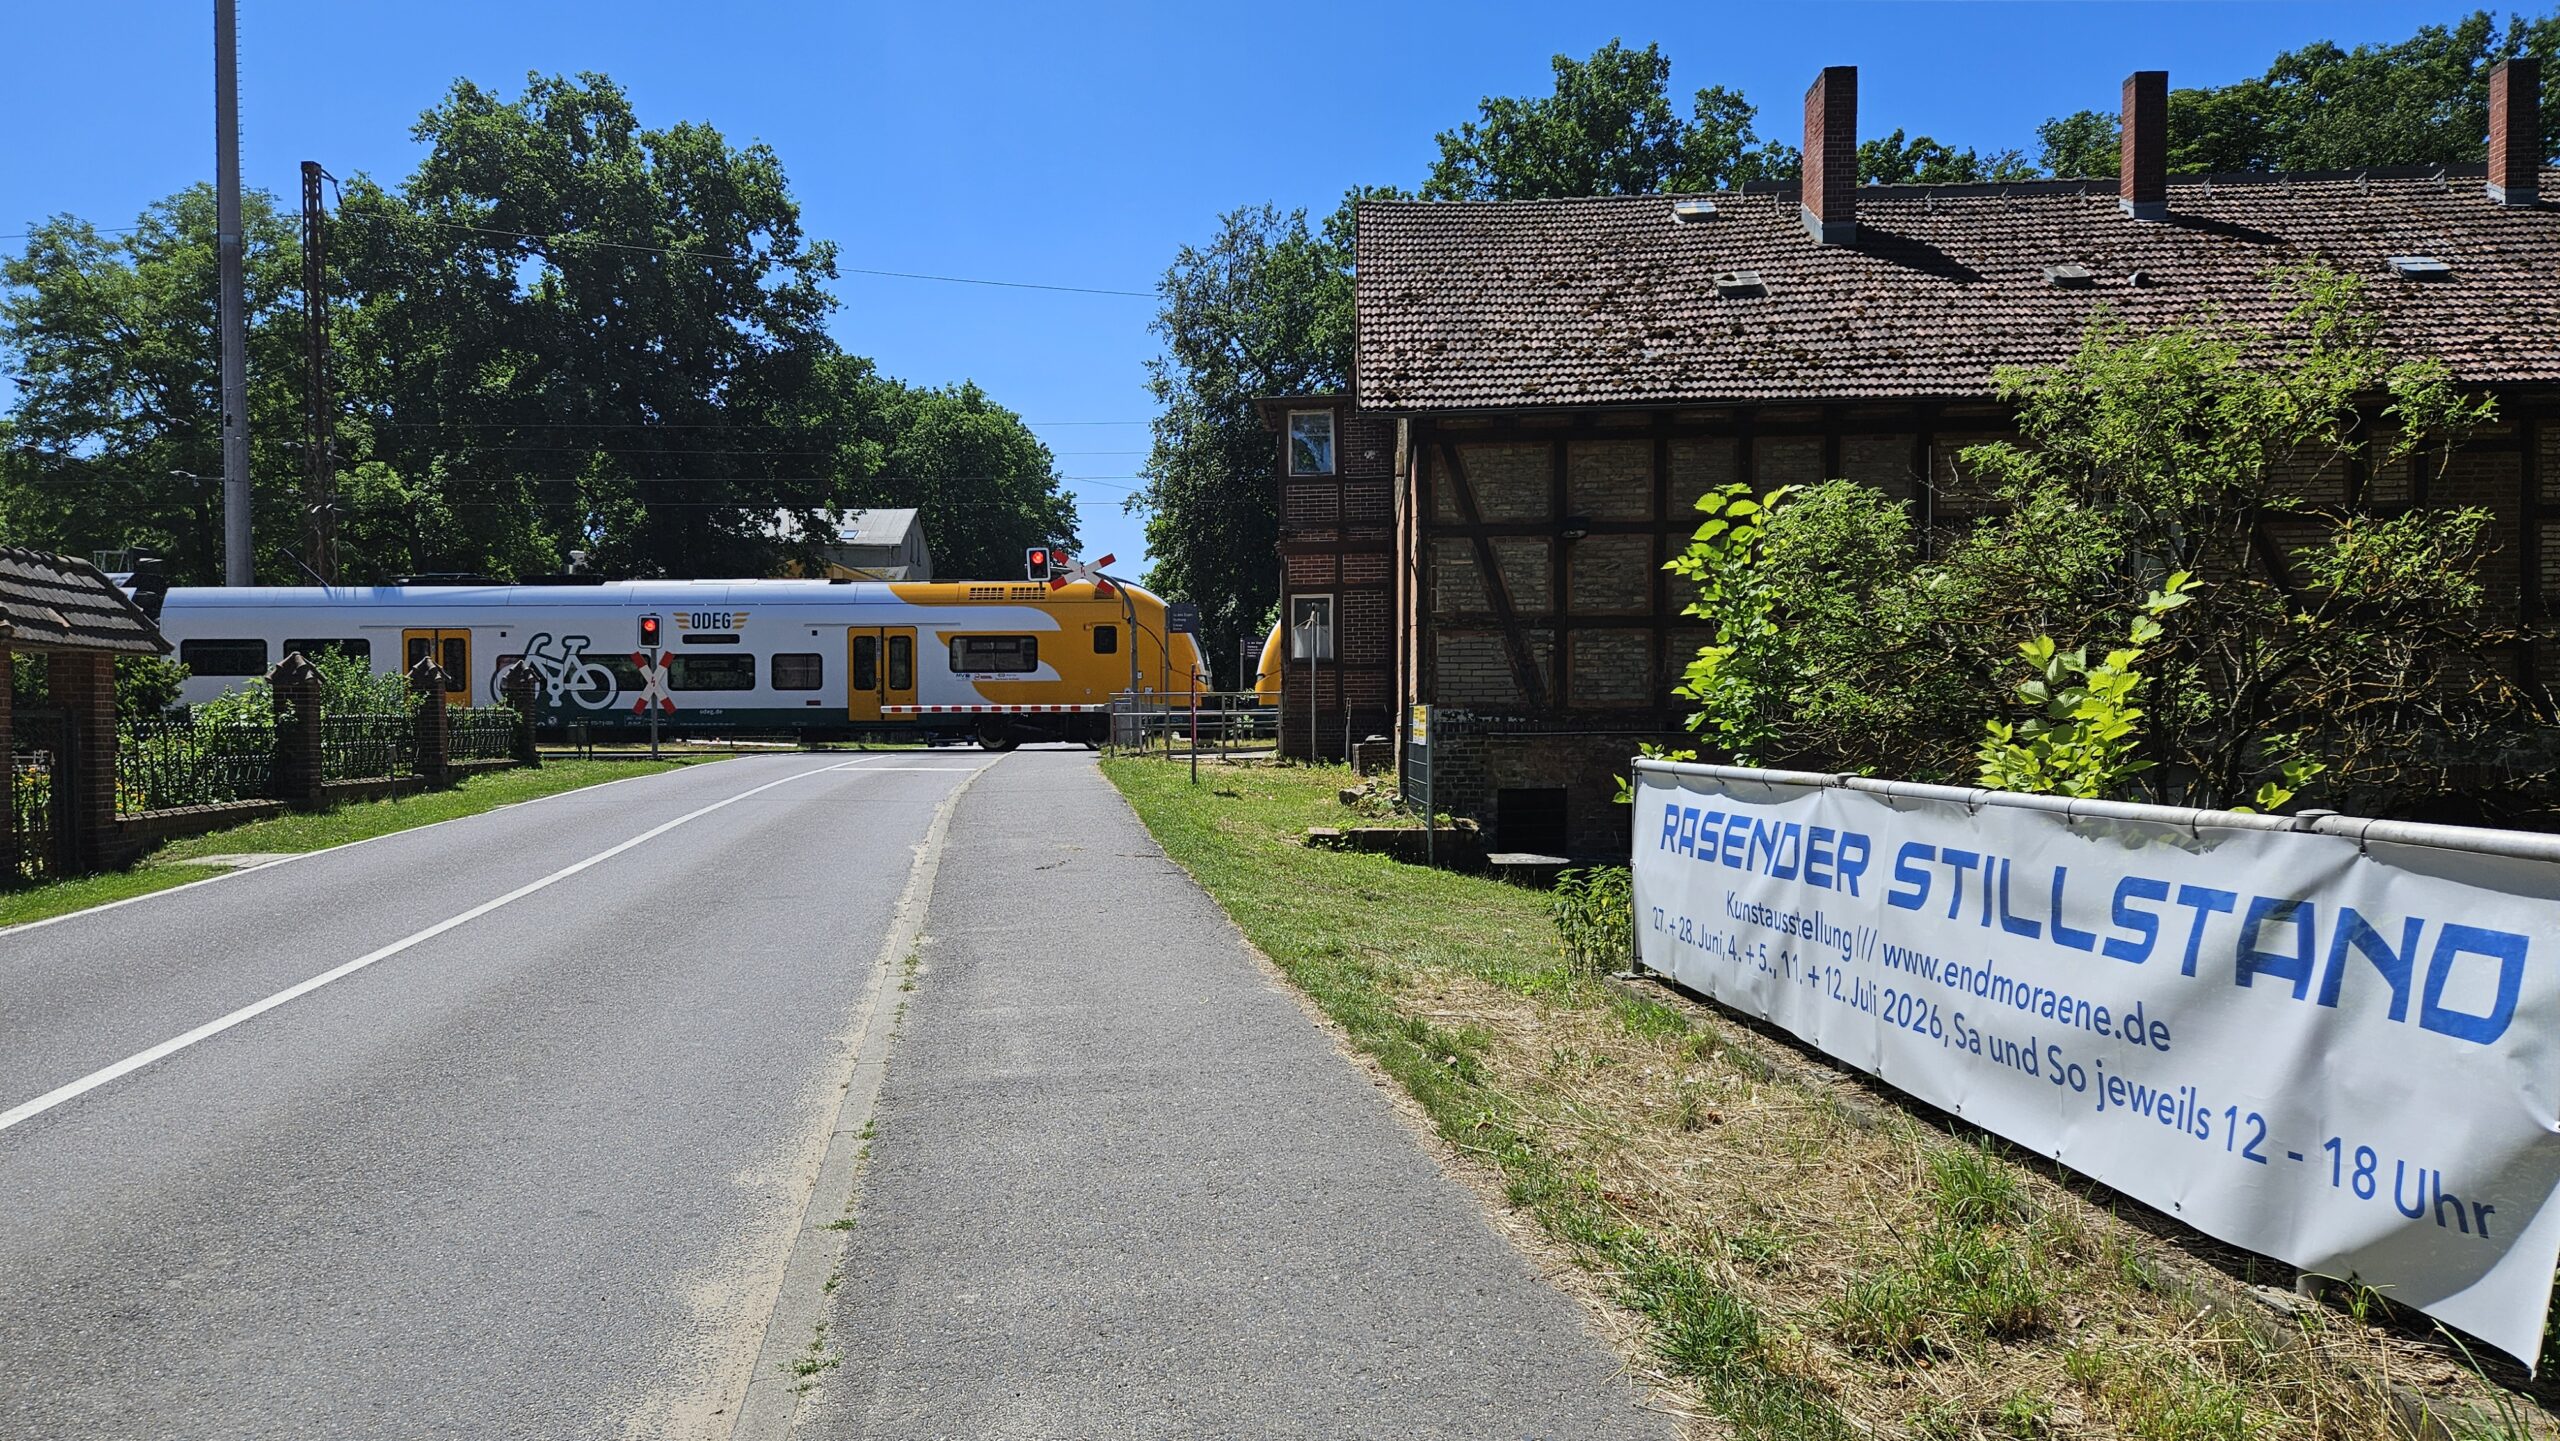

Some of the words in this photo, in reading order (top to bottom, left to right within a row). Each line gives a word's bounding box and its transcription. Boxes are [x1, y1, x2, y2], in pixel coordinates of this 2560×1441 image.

[691, 612, 732, 630] ODEG
[699, 708, 724, 716] odeg.de
[1660, 803, 1872, 898] RASENDER
[1887, 841, 2530, 1046] STILLSTAND
[1726, 890, 1852, 962] Kunstausstellung
[1883, 942, 2172, 1051] www.endmoraene.de
[1652, 906, 1668, 935] 27.
[1669, 917, 1676, 936] +
[1679, 916, 1696, 946] 28.
[1698, 924, 1726, 962] Juni,
[1728, 935, 1742, 963] 4.
[1745, 944, 1755, 966] +
[1758, 943, 1777, 979] 5.,
[1781, 950, 1803, 985] 11.
[1807, 965, 1820, 988] +
[1825, 965, 1846, 1003] 12.
[1850, 976, 1878, 1017] Juli
[1883, 988, 1949, 1049] 2026,
[1954, 1012, 1982, 1056] Sa
[1989, 1035, 2040, 1078] und
[2047, 1044, 2088, 1093] So
[2096, 1059, 2212, 1141] jeweils
[2224, 1105, 2267, 1165] 12
[2286, 1151, 2304, 1162] -
[2323, 1136, 2378, 1200] 18
[2394, 1159, 2496, 1239] Uhr
